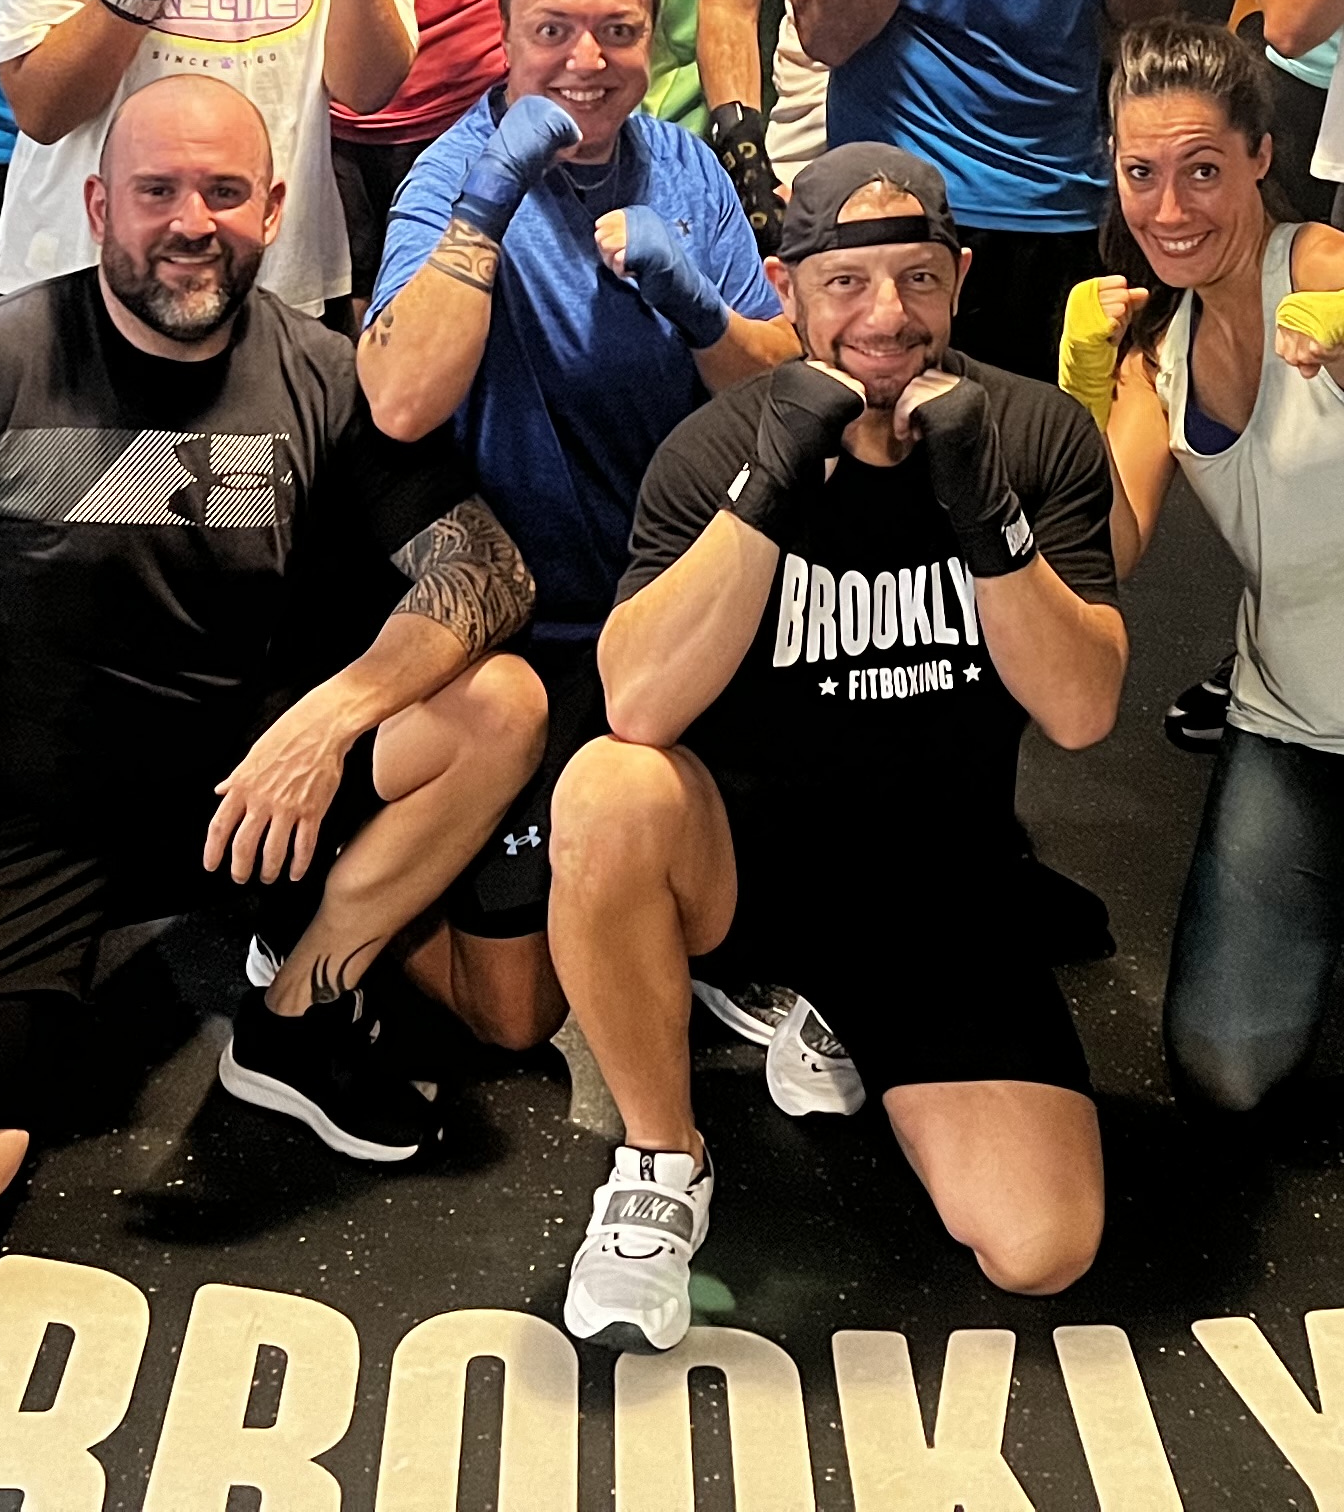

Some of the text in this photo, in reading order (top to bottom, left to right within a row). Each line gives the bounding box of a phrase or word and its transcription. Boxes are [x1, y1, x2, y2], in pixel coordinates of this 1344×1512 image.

[152, 50, 276, 69] SINCE 160
[773, 553, 979, 668] BROOKLY
[848, 659, 954, 700] FITBOXING
[619, 1194, 679, 1224] NIKE
